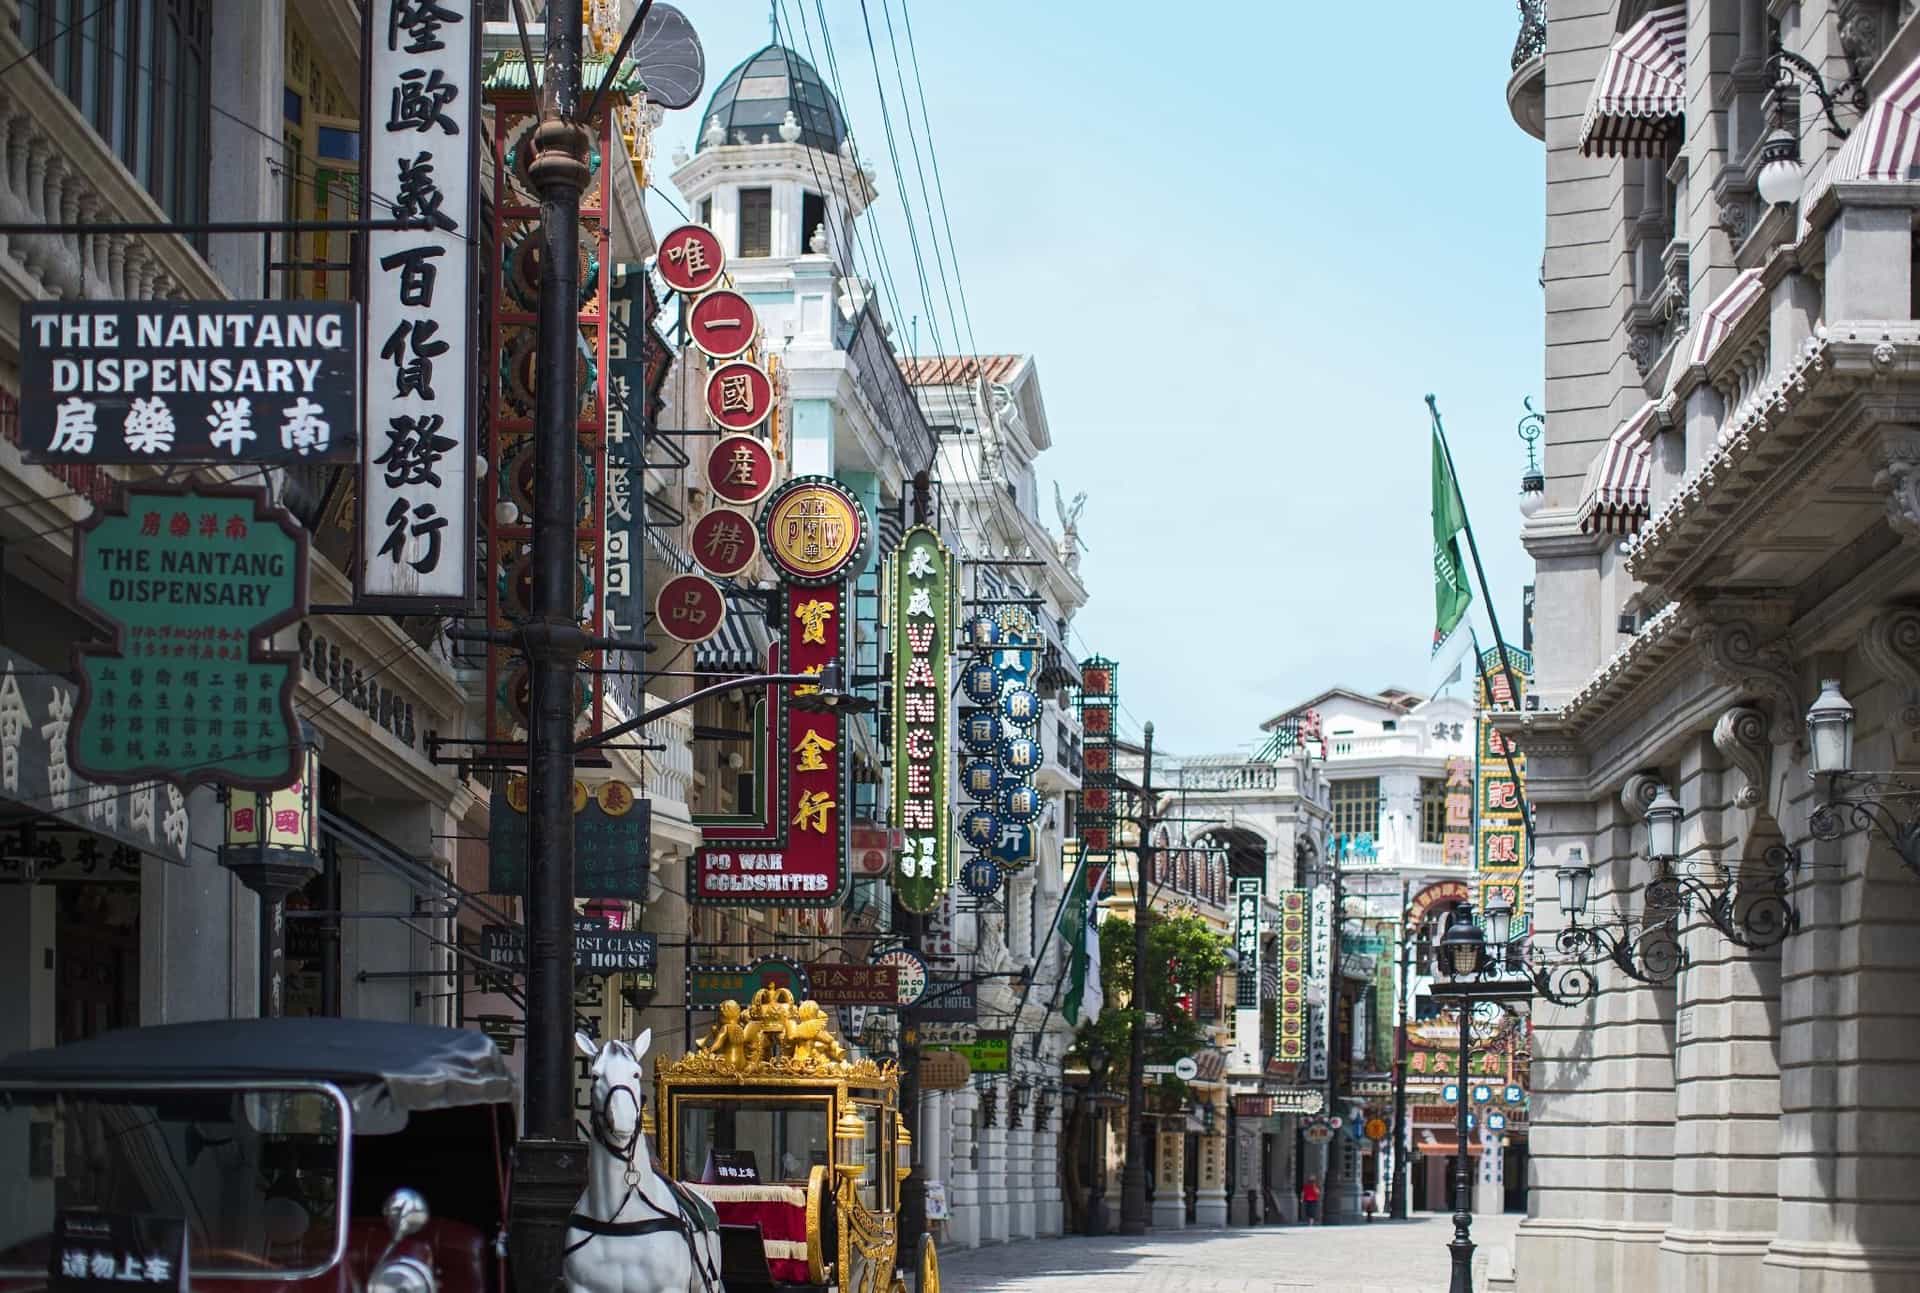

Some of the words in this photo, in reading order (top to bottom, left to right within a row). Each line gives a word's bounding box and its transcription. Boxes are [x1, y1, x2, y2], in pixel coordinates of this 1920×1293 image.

[31, 314, 119, 348] THE
[136, 314, 343, 348] NANTANG
[52, 358, 323, 393] DISPENSARY
[98, 549, 158, 574] THE
[161, 549, 284, 577] NANTANG
[109, 578, 271, 608] DISPENSARY
[902, 622, 937, 830] VANCEN
[705, 853, 731, 870] PO
[738, 853, 783, 870] WAH
[705, 874, 829, 890] GOLDSMITHS
[607, 938, 649, 951] CLASS
[591, 953, 649, 968] HOUSE
